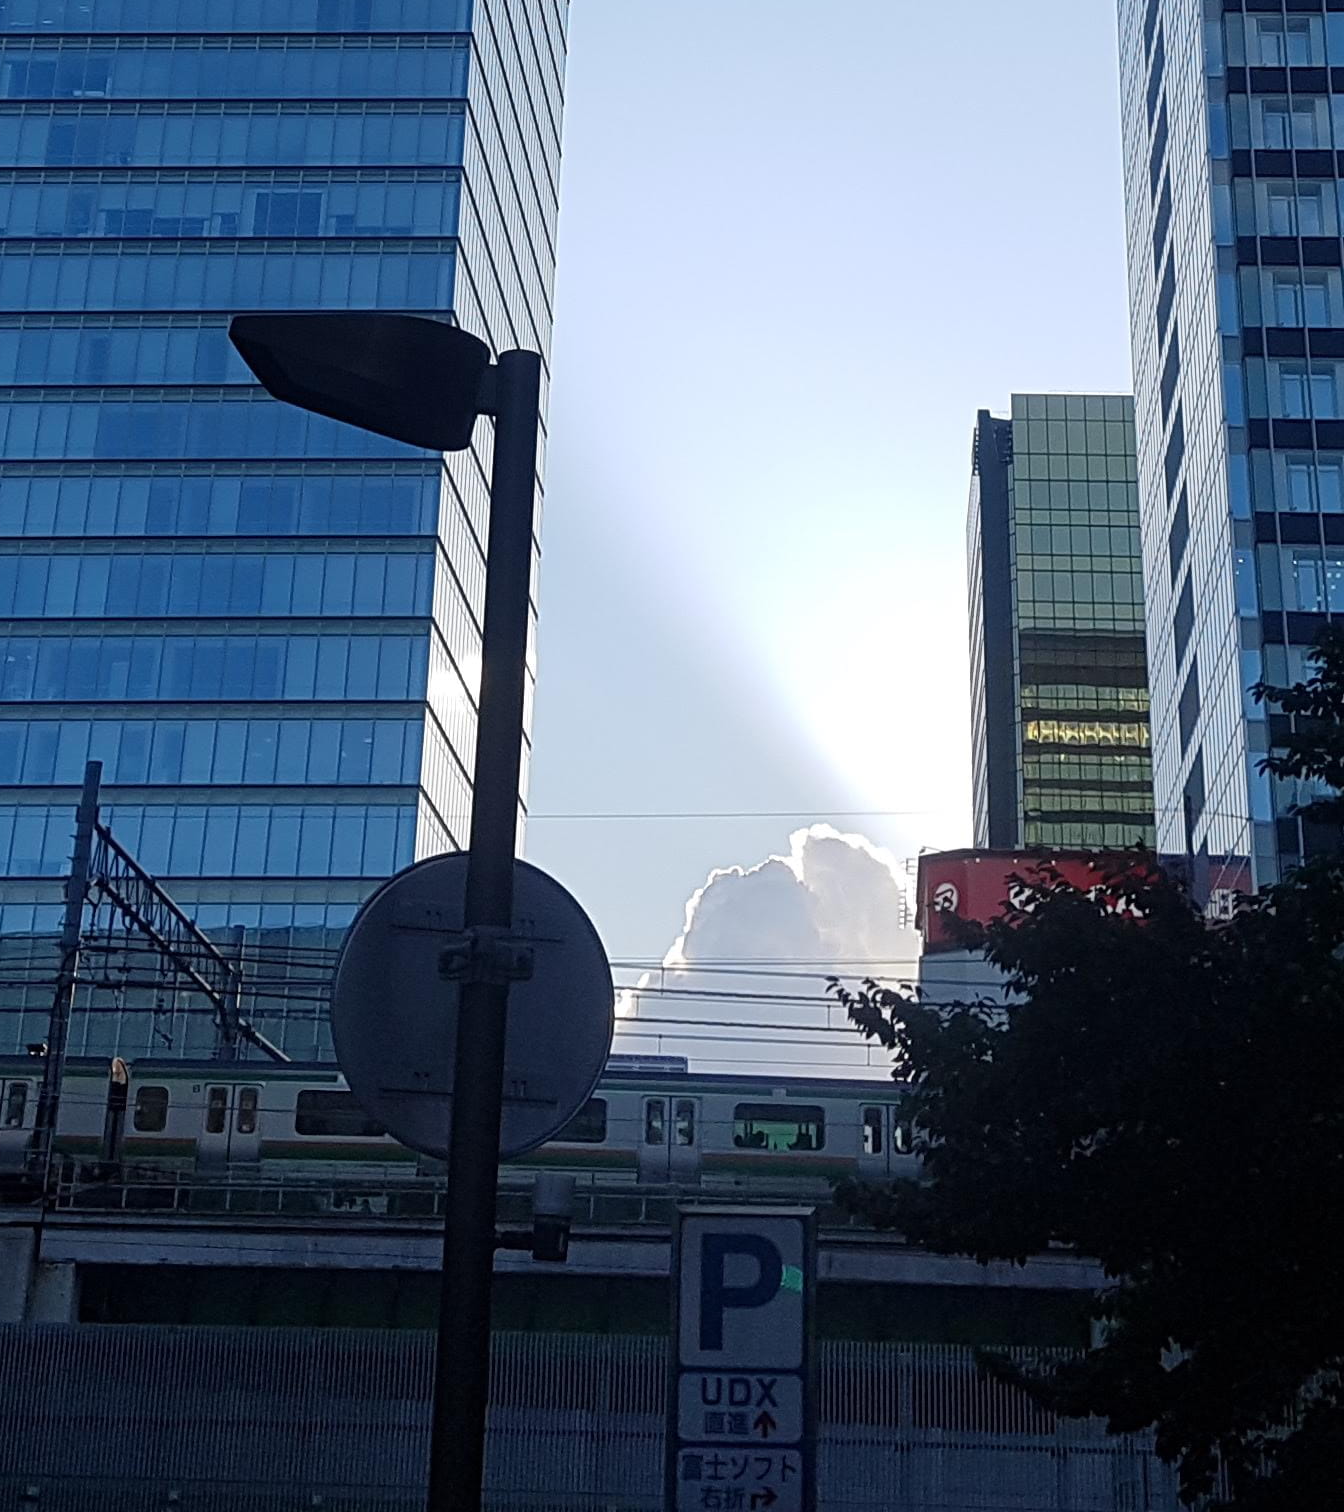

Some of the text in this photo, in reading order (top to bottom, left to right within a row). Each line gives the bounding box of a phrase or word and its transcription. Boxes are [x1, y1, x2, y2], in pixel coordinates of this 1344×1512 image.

[699, 1233, 783, 1351] P
[701, 1377, 778, 1407] UDX
[682, 1454, 796, 1482] 富士ソフト
